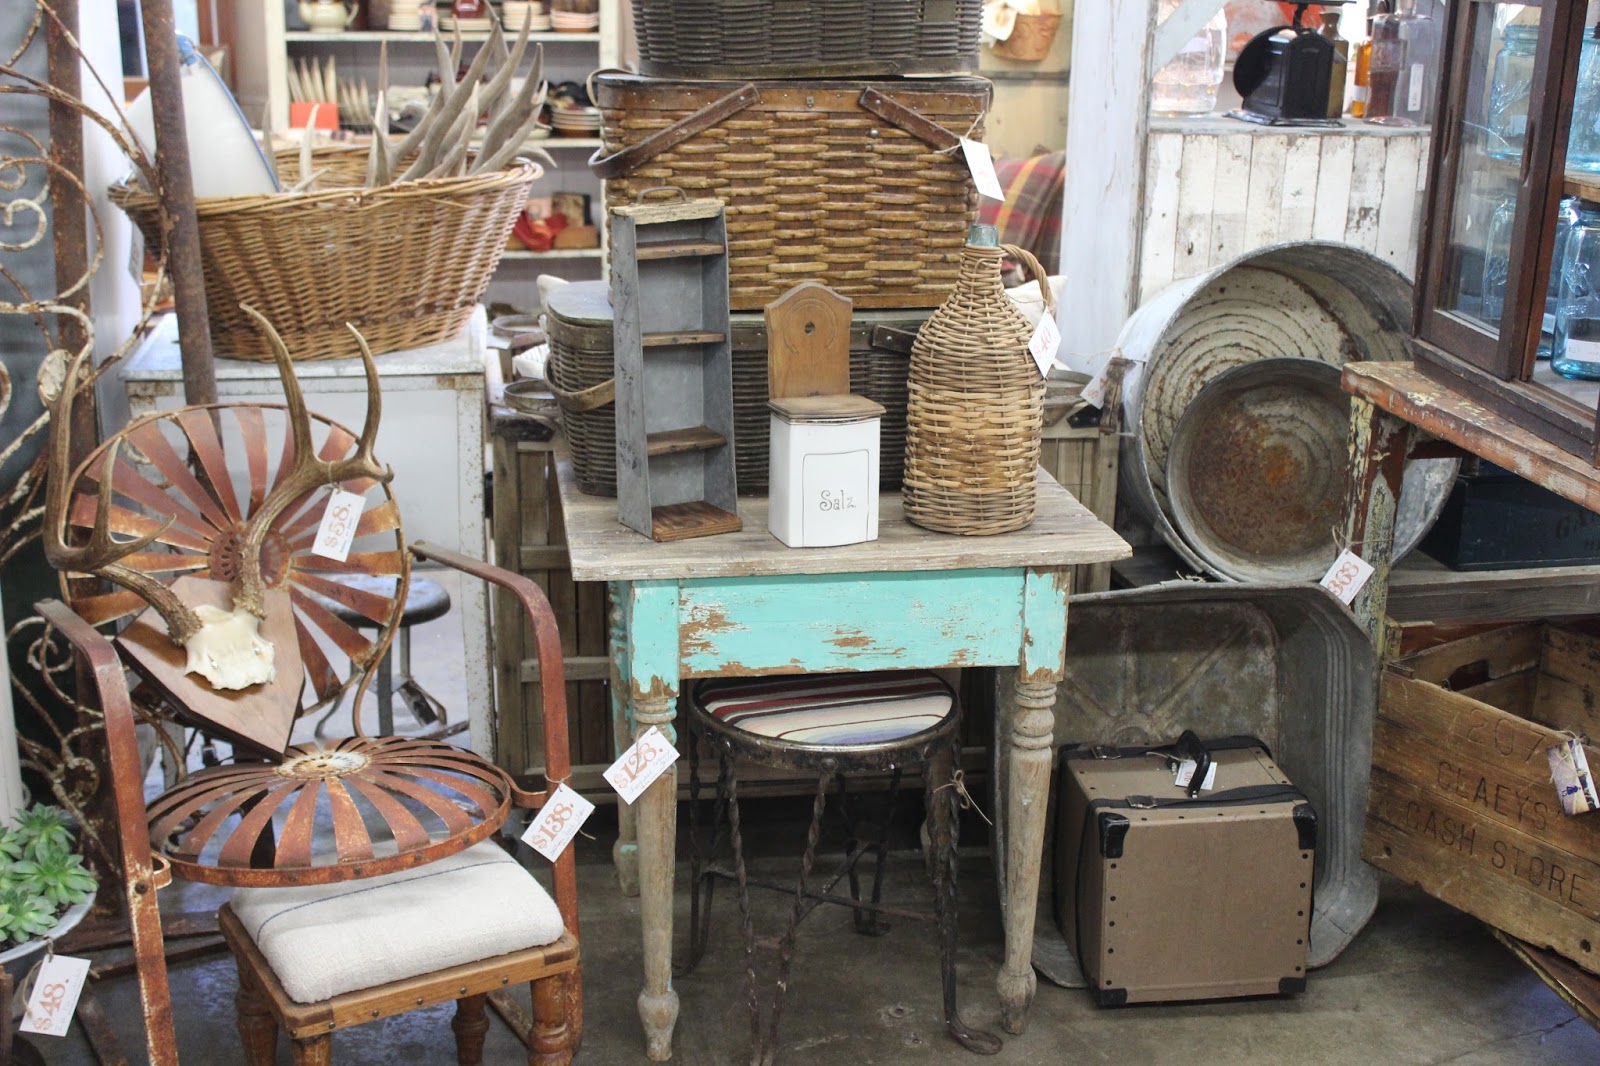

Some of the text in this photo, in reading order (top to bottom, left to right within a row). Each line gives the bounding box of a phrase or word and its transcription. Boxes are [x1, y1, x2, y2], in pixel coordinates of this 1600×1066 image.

[819, 489, 857, 512] Salz
[1467, 707, 1547, 762] 207
[1406, 801, 1588, 907] CASH STORE
